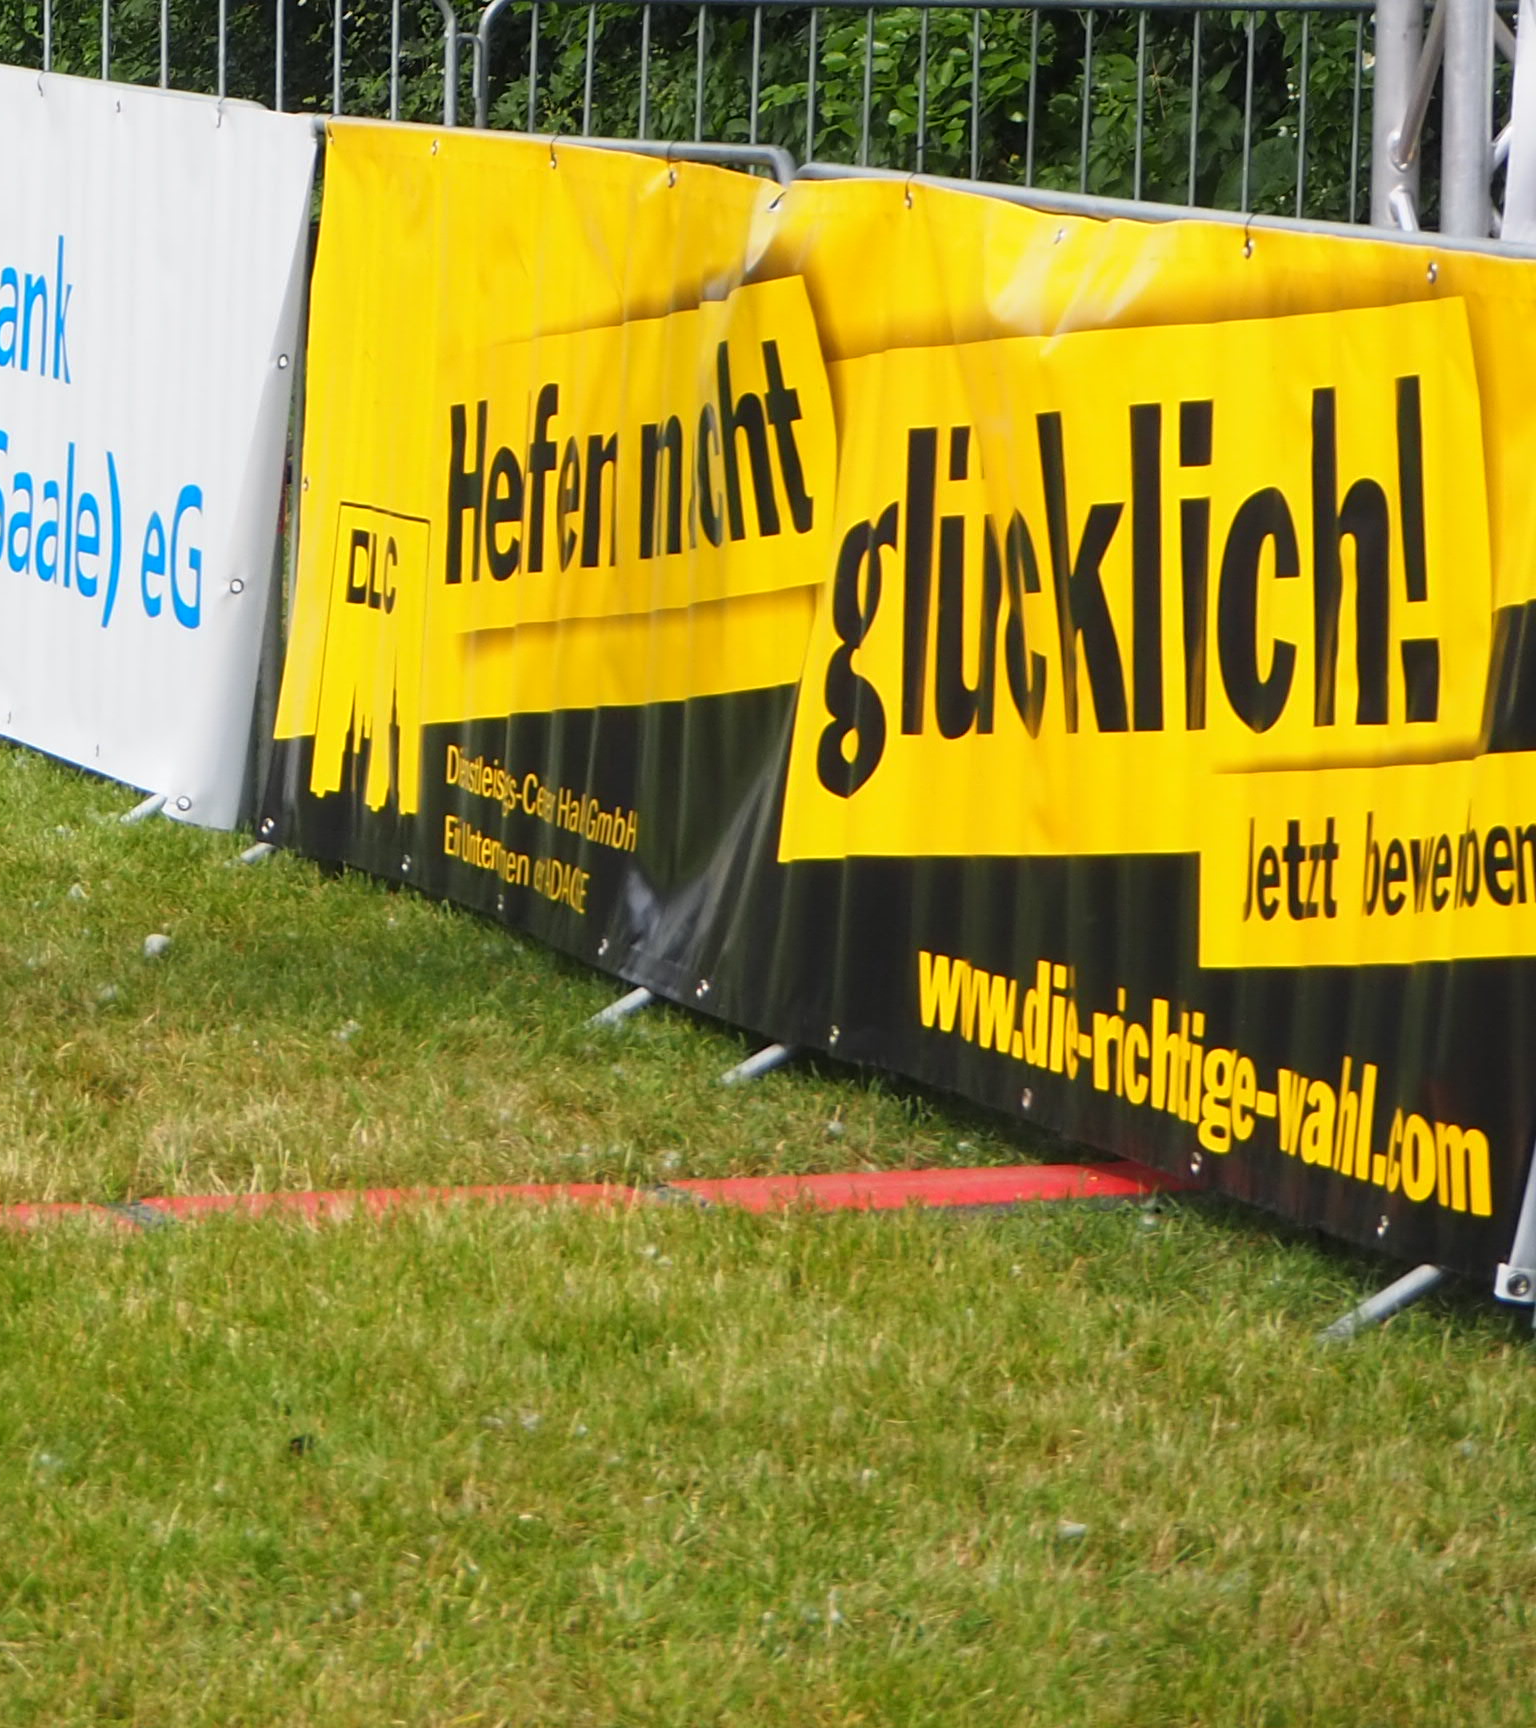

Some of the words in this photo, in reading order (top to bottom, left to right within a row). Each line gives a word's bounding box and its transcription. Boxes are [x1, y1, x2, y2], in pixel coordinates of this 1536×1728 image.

[140, 484, 203, 629] eG
[345, 528, 399, 616] DLC
[816, 374, 1440, 799] glücklich!
[1242, 816, 1340, 923] Jetzt
[918, 950, 1493, 1217] www.die-richtige-wahl.com
